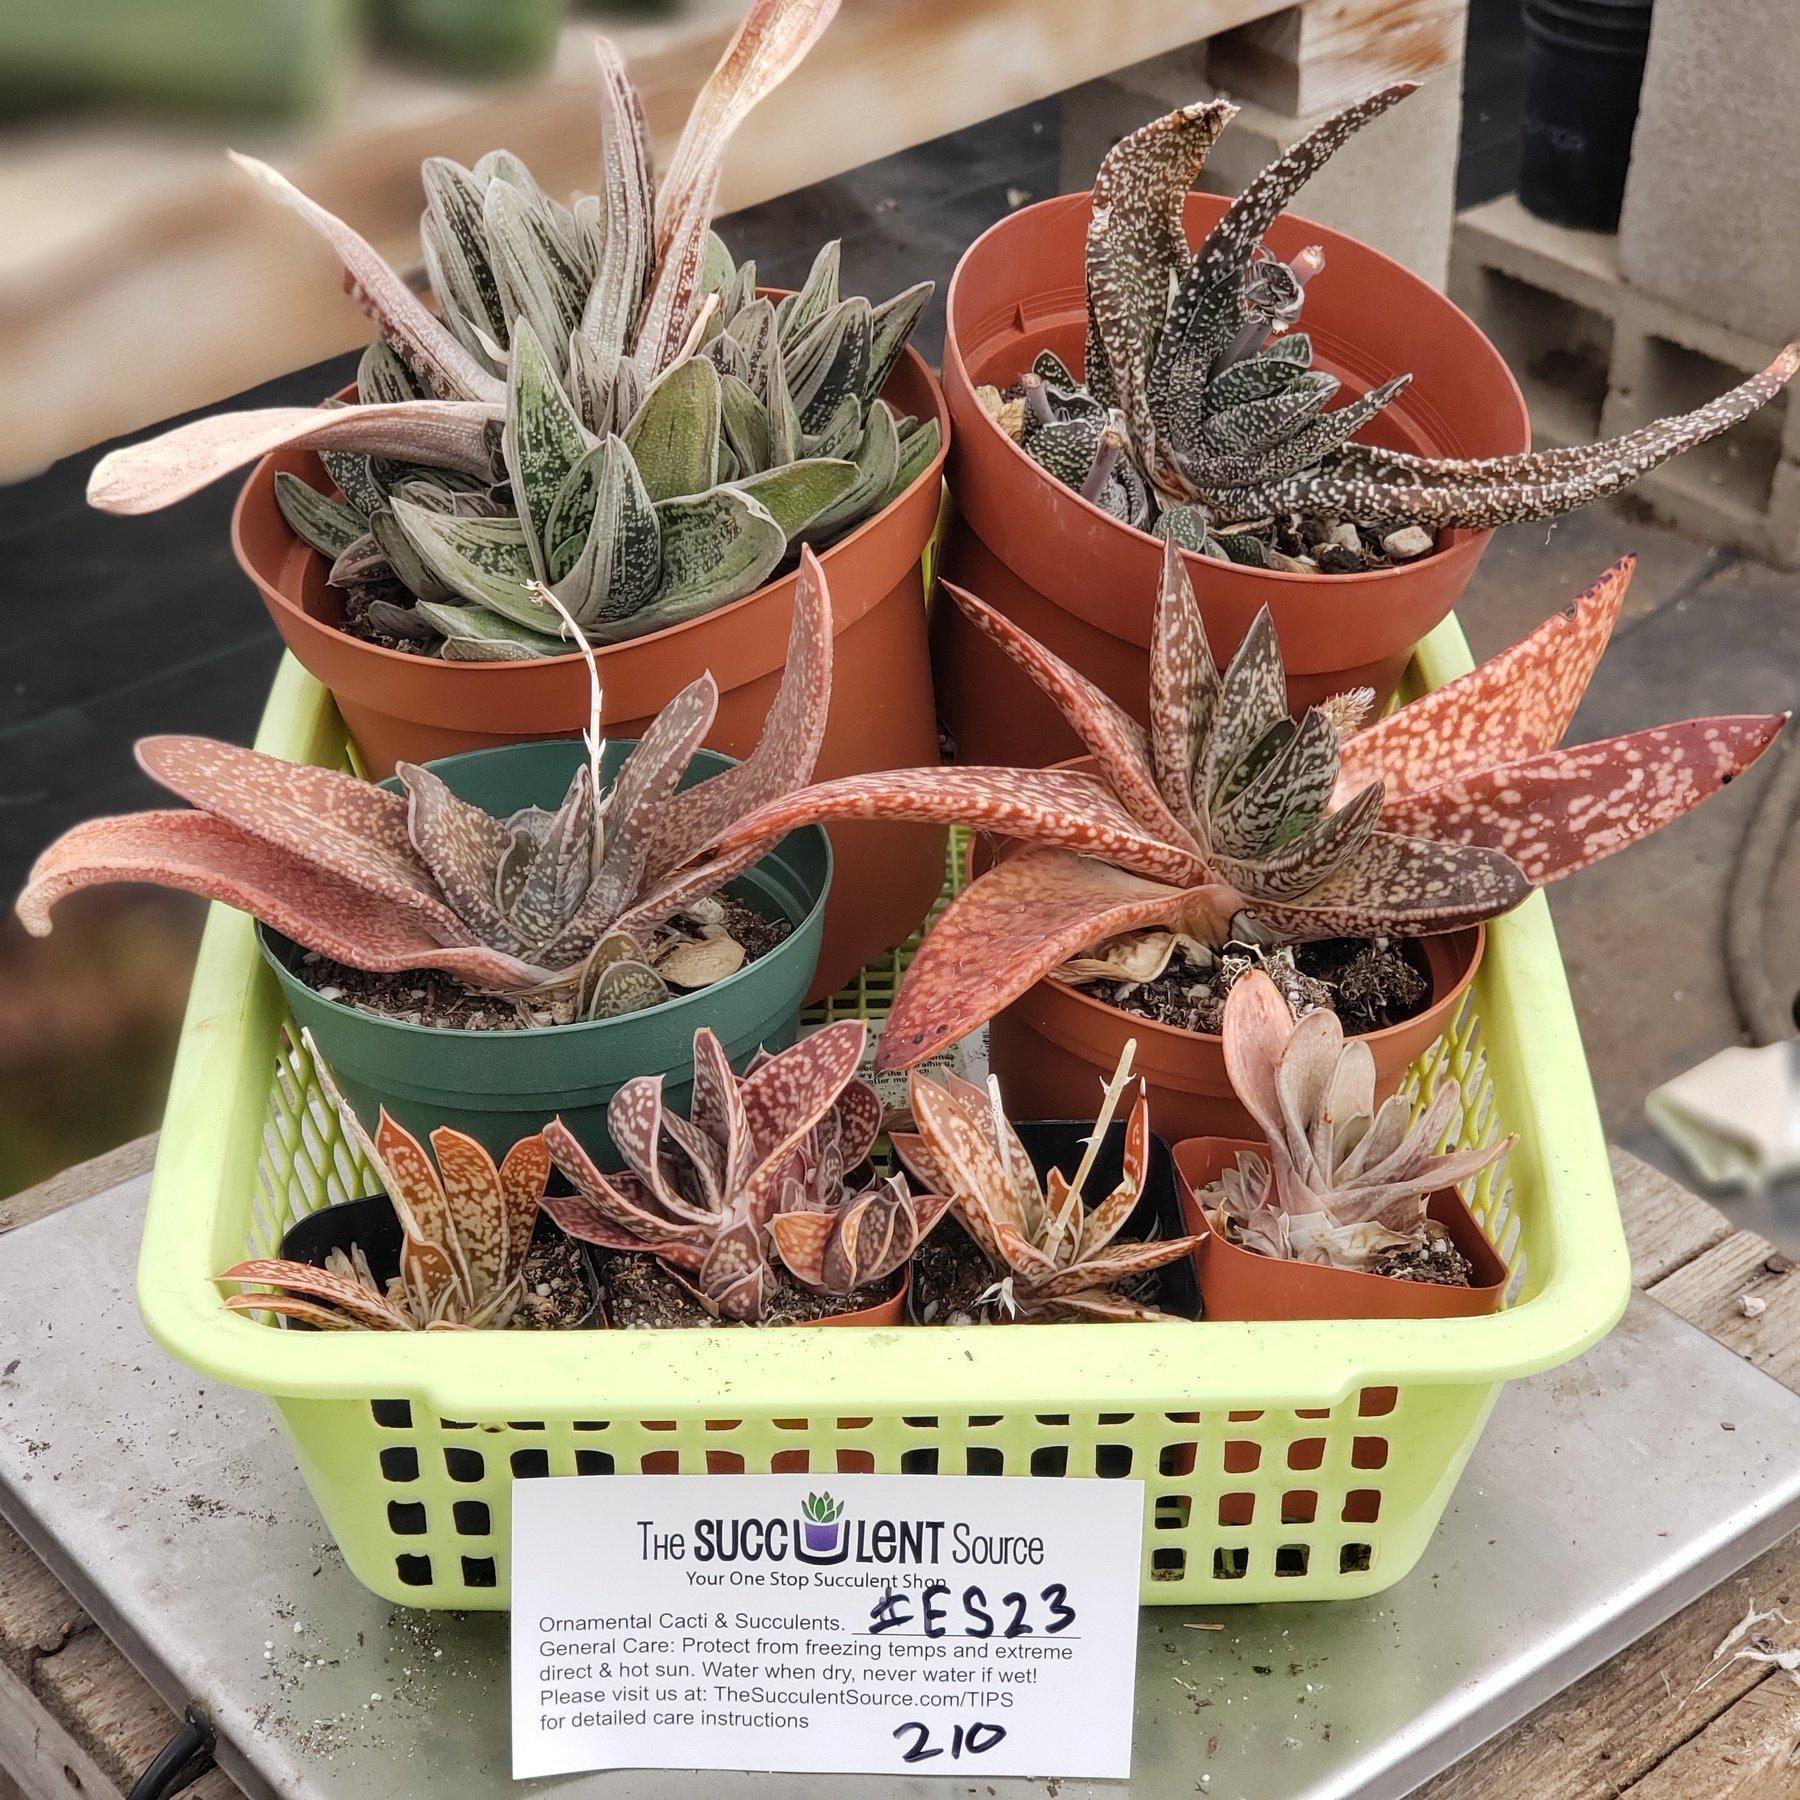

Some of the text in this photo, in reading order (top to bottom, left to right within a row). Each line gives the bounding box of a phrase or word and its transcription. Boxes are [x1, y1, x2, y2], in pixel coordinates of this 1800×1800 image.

[952, 1522, 1045, 1566] Source
[685, 1571, 947, 1591] Your One Stop Succulent Shop
[539, 1612, 846, 1633] Ornamental Cacti & Succulents.
[539, 1637, 1073, 1661] General Care: Protect from freezing temps and extreme
[539, 1661, 1037, 1685] direct & hot sun. Water when dry, never water if wet!
[540, 1685, 1014, 1708] Please visit us at: TheSucculentSource.com/TIPS
[540, 1709, 809, 1730] for detailed care instructions
[892, 1721, 1007, 1764] 210
